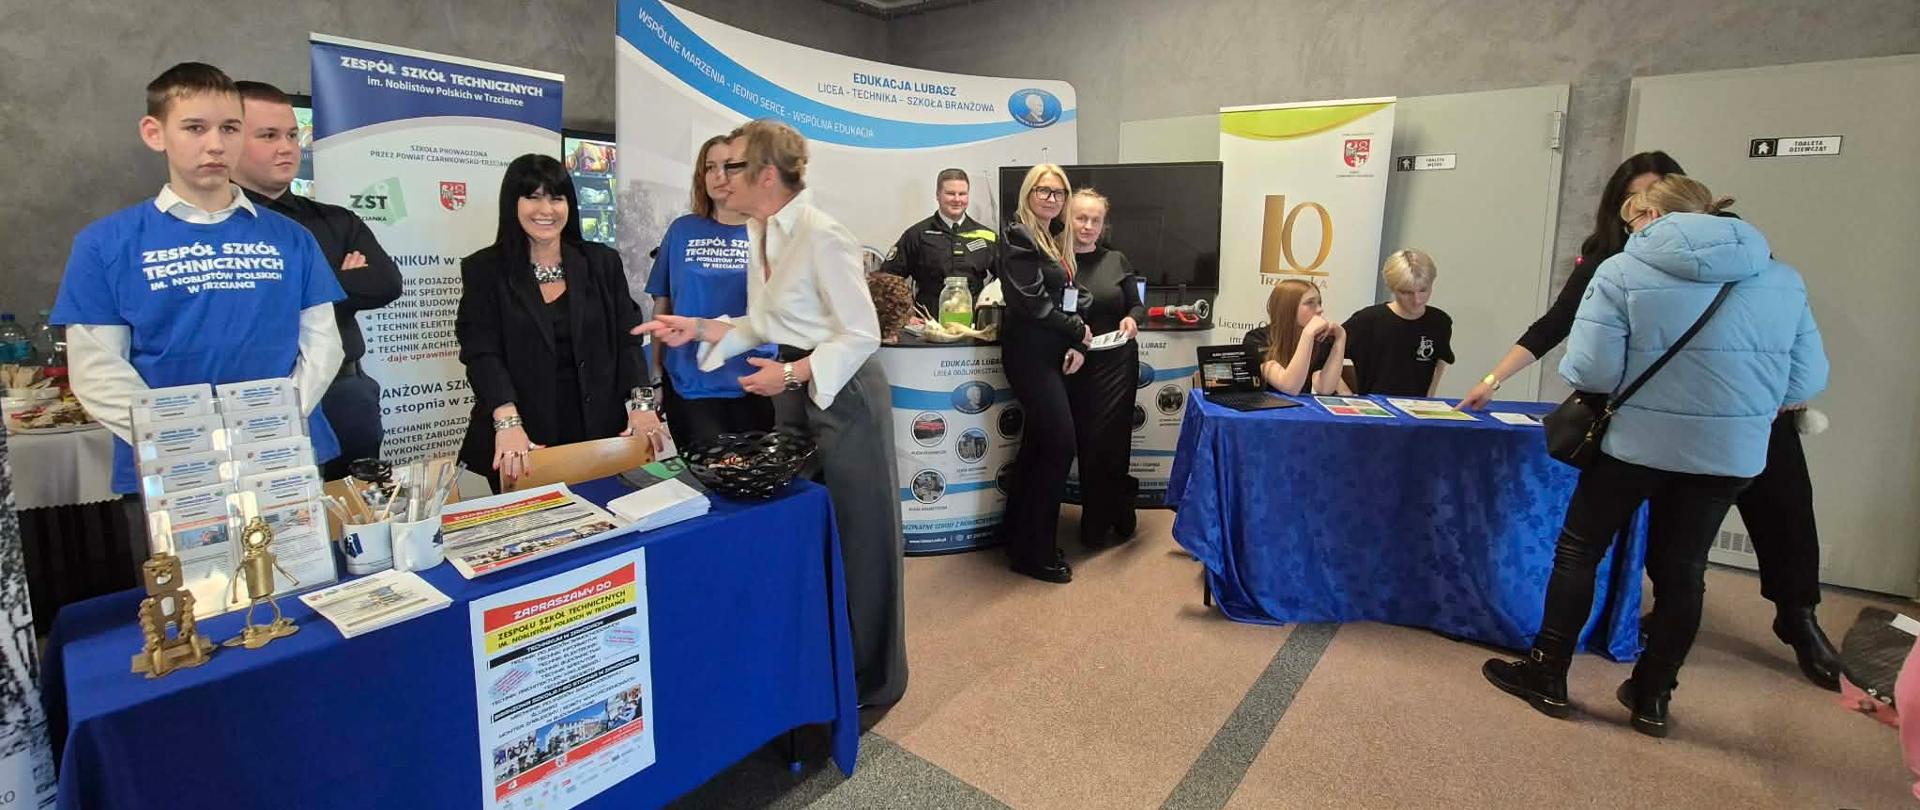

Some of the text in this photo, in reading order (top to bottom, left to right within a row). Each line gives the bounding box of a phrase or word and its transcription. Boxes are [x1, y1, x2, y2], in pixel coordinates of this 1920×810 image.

[340, 55, 543, 96] ZESPÓŁ SZKÓŁ TECHNICZNYCH
[638, 8, 680, 53] WSPÓLNE
[681, 47, 726, 86] MARZENIA
[732, 82, 758, 105] JEDNO
[760, 96, 785, 116] SERCE
[793, 110, 833, 130] WSPÓLNA
[834, 122, 874, 137] EDUKACJA
[368, 76, 523, 106] im. Noblistów Polskich w Trzciance
[853, 72, 957, 97] EDUKACJA LUBASZ
[817, 82, 844, 96] LICEA
[851, 88, 897, 104] TECHNIKA
[907, 96, 943, 109] SZKOŁA
[945, 99, 995, 112] BRANŻOWA
[350, 194, 388, 209] ZST
[687, 236, 727, 247] ZESPÓŁ
[142, 240, 280, 264] ZESPÓŁ SZKÓŁ
[142, 257, 284, 281] TECHNICZNYCH
[151, 270, 282, 291] IM. NOBLISTÓW POLSKICH
[187, 280, 256, 294] W TRZCIANCE
[376, 311, 418, 321] TECHNIK
[1218, 315, 1254, 330] Liceum
[376, 321, 418, 331] TECHNIK
[377, 331, 419, 343] TECHNIK
[378, 343, 419, 354] TECHNIK
[940, 359, 980, 368] EDUKACJA
[395, 398, 445, 413] stopnia
[448, 397, 460, 406] w
[383, 421, 431, 435] MECHANIK
[383, 434, 423, 447] MONTER
[513, 579, 611, 620] ZAPRASZAMY DO
[497, 589, 625, 640] ZESPOŁU SZKÓŁ TECHNICZNYCH
[511, 623, 551, 643] NOBLISTÓW
[554, 612, 583, 627] POLSKICH
[595, 597, 625, 613] TRZCIANCE
